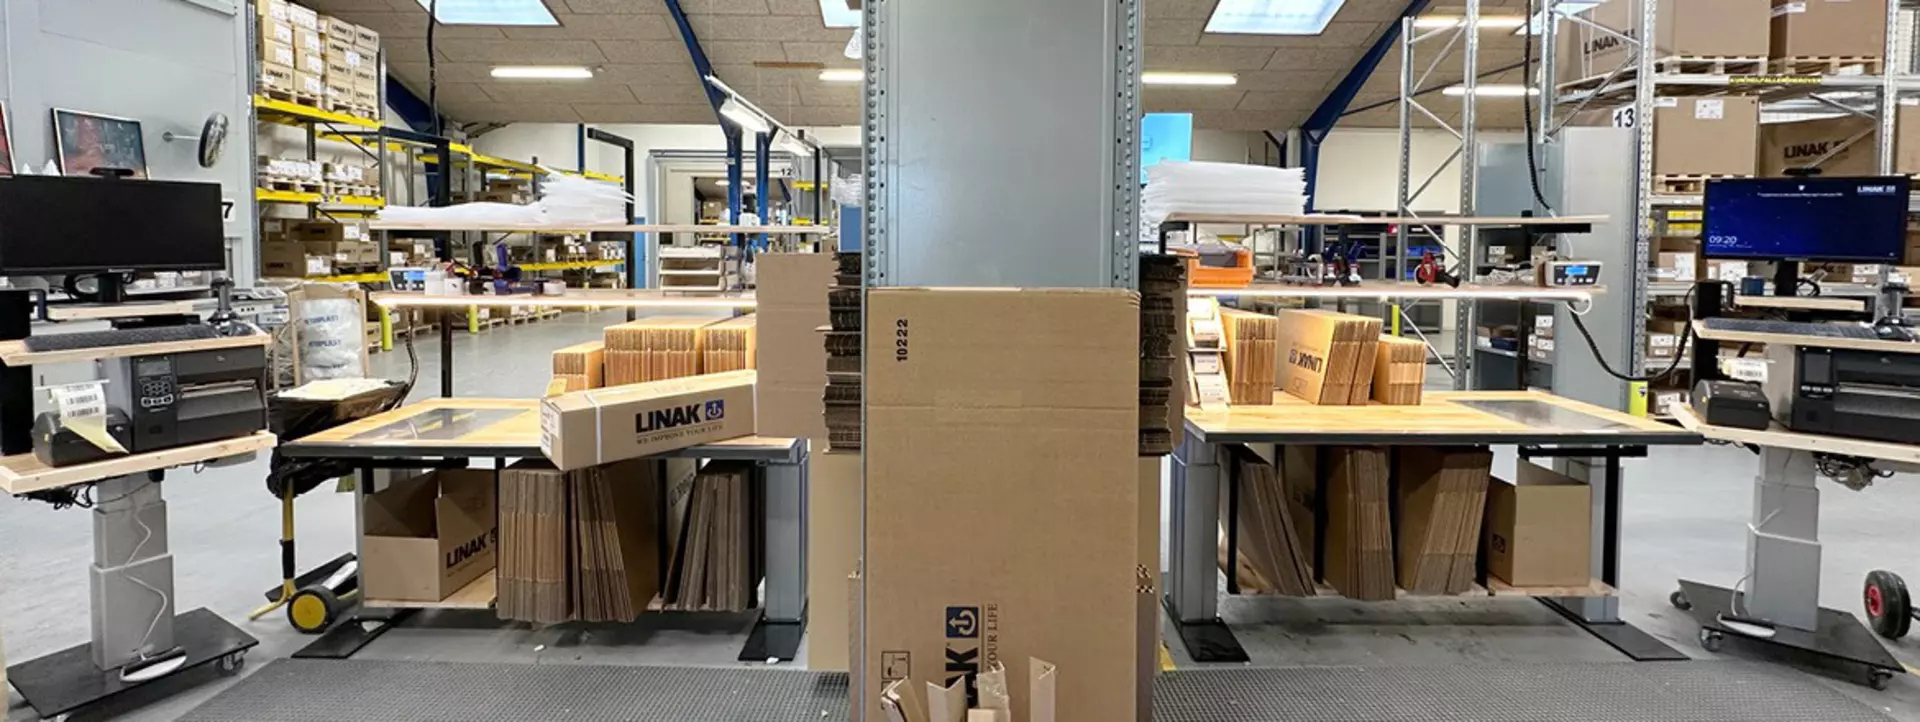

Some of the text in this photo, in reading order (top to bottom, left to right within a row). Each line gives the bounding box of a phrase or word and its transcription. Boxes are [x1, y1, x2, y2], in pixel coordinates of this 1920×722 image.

[1614, 107, 1634, 128] 13
[1784, 142, 1828, 158] LINAK
[781, 167, 793, 177] 12
[896, 318, 909, 362] 10222
[635, 403, 701, 433] LINAK
[636, 436, 649, 445] WE
[447, 531, 489, 569] LINAK
[987, 603, 998, 671] YOUR LIFE
